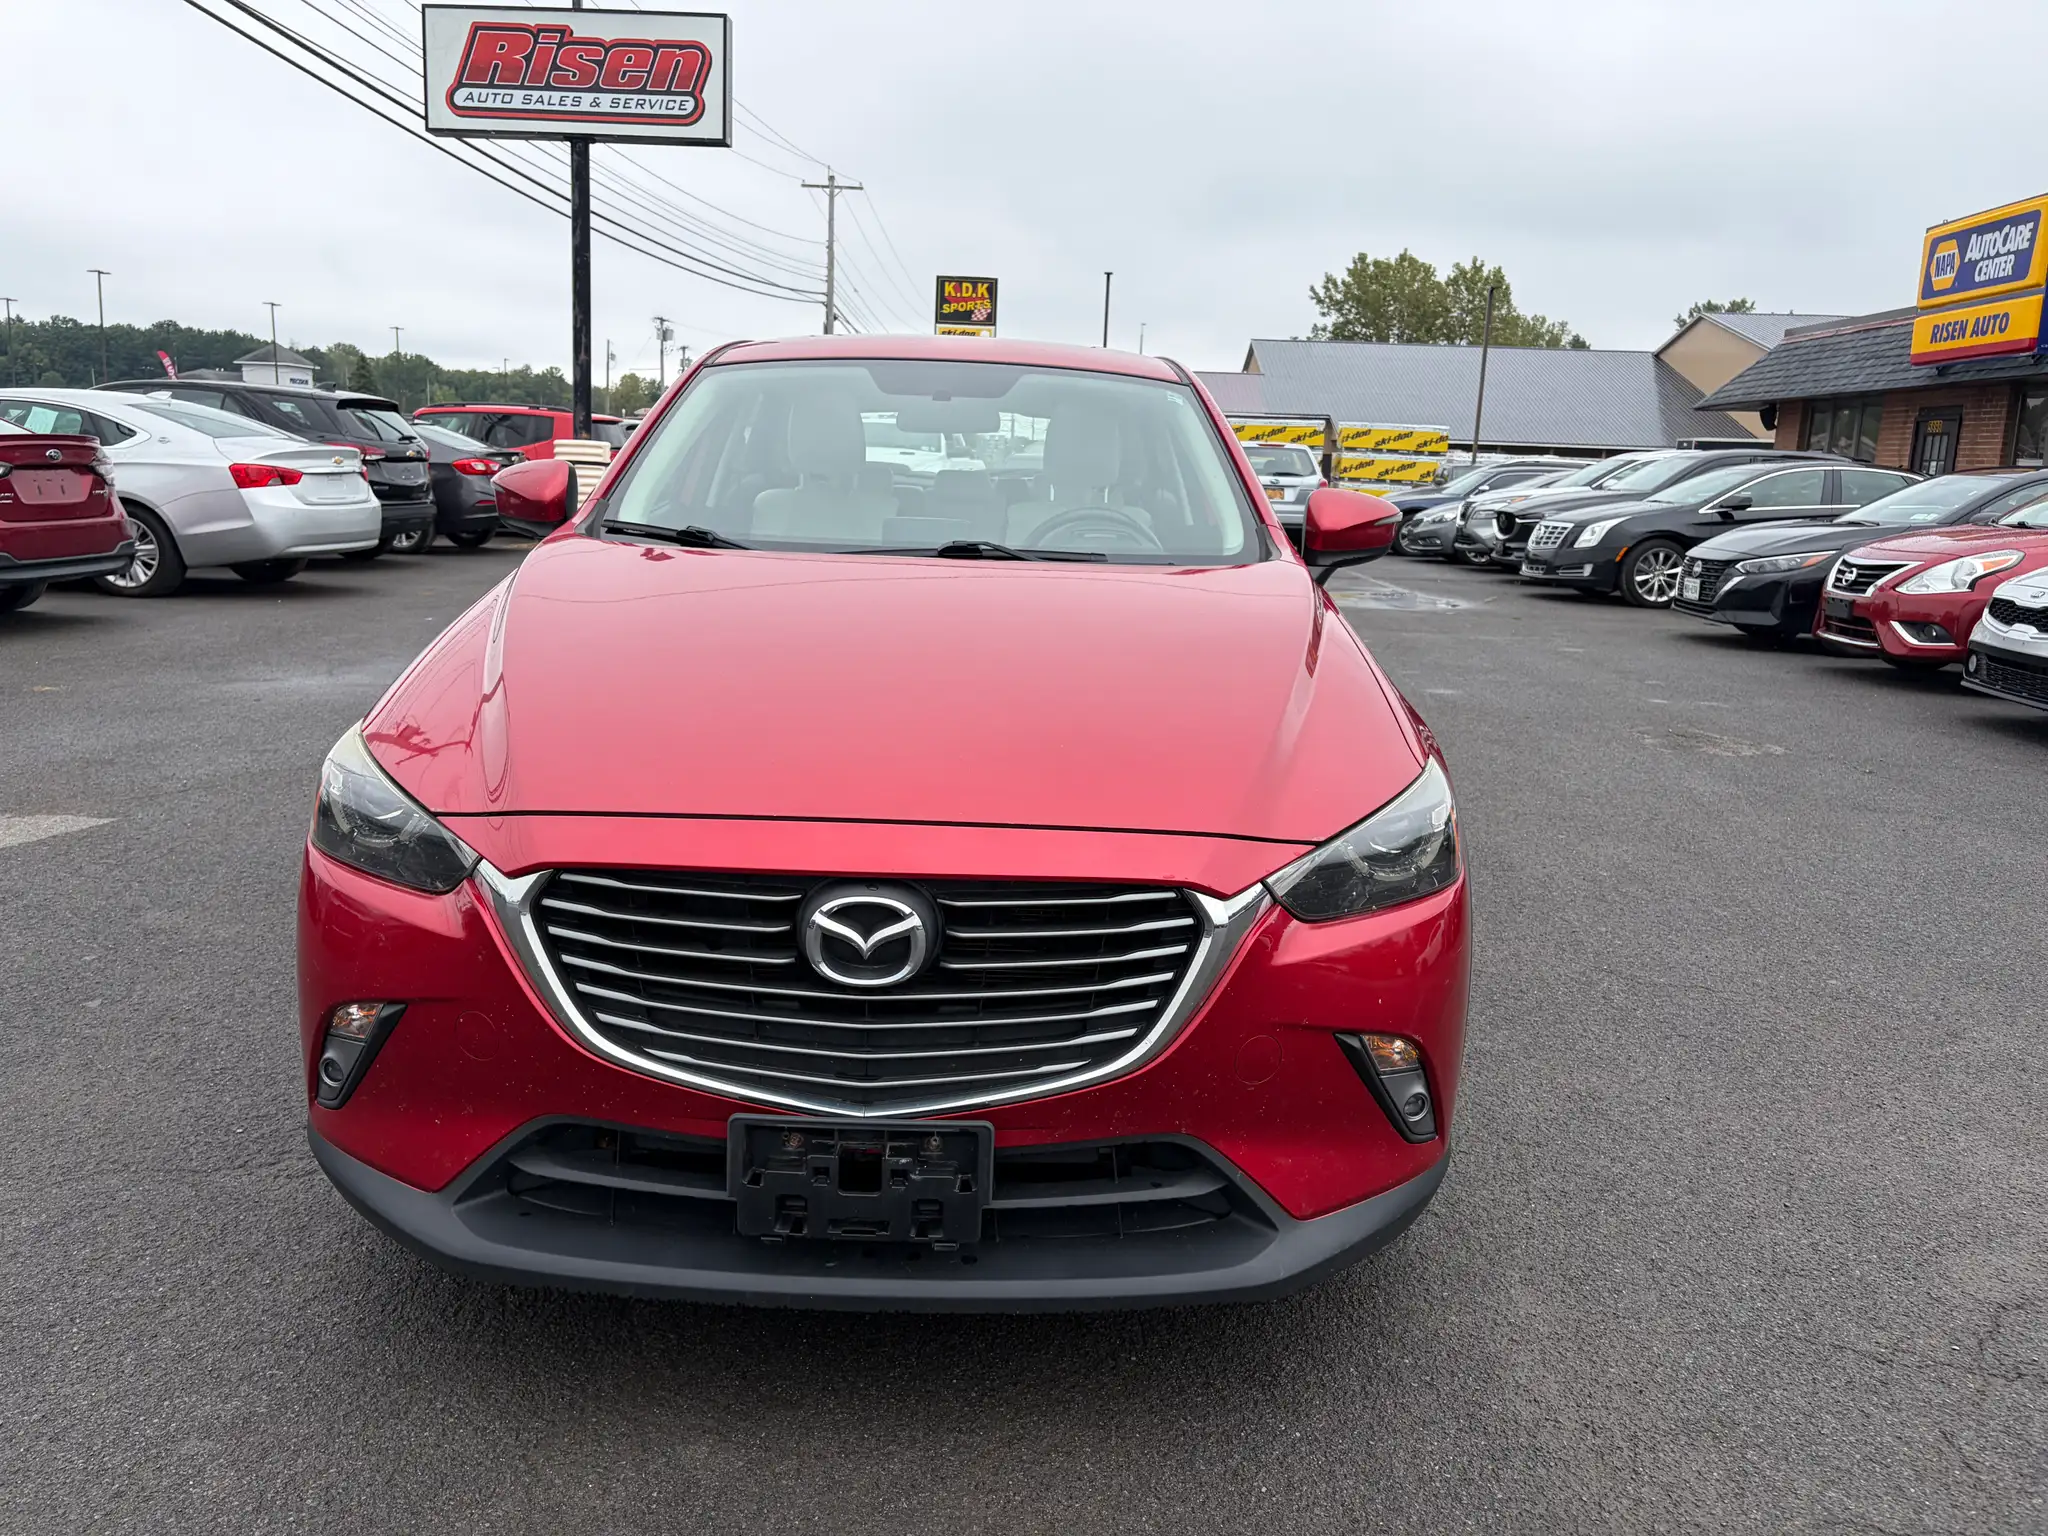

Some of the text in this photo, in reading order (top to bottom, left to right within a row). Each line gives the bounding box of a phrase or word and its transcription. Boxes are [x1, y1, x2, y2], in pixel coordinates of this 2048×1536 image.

[462, 30, 702, 91] Risen
[462, 92, 690, 112] AUTO SALES & SERVICE
[1934, 252, 1956, 279] NAPA
[1975, 254, 2014, 283] CENTER
[945, 282, 989, 298] K.D.K
[941, 299, 992, 314] SPORTS
[1930, 312, 2010, 344] RISEN AUTO
[1374, 431, 1414, 448] ski-doo
[1377, 462, 1417, 479] ski-doo
